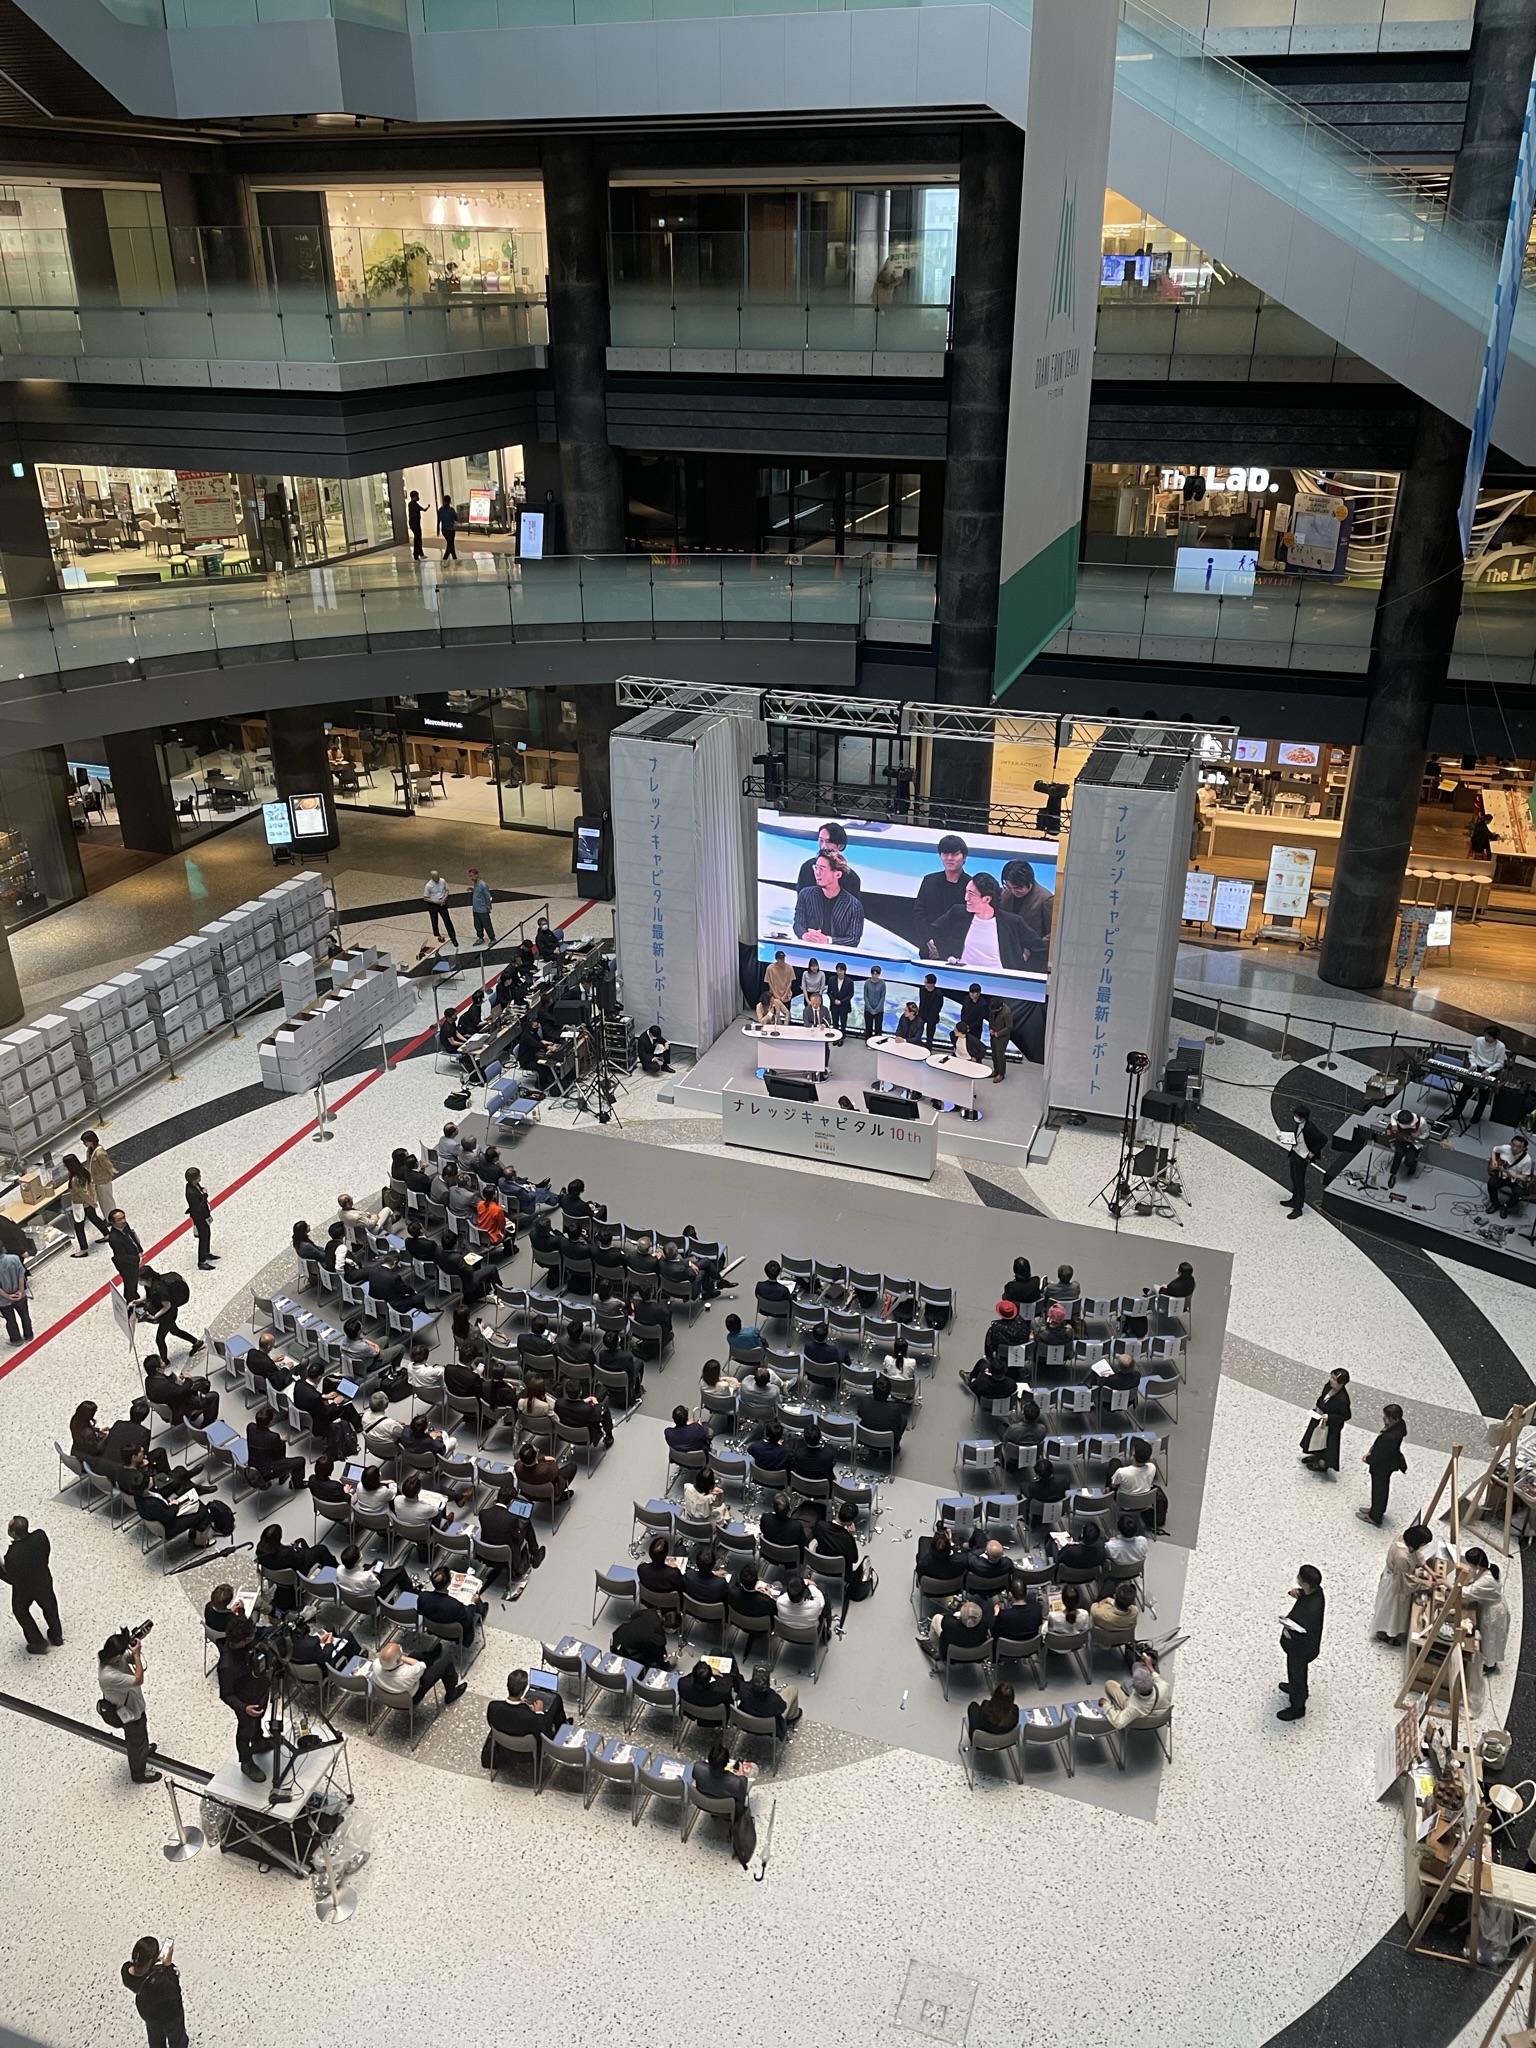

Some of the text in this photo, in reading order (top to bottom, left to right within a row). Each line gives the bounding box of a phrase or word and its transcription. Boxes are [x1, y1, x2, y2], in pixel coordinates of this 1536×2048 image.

[1161, 469, 1186, 490] Th
[1486, 556, 1536, 583] The La
[1198, 770, 1229, 785] Lab.
[648, 757, 666, 1025] ナレッジキャピタル最新レポート
[1090, 805, 1129, 1095] ナレッジキャピタル最新レポート
